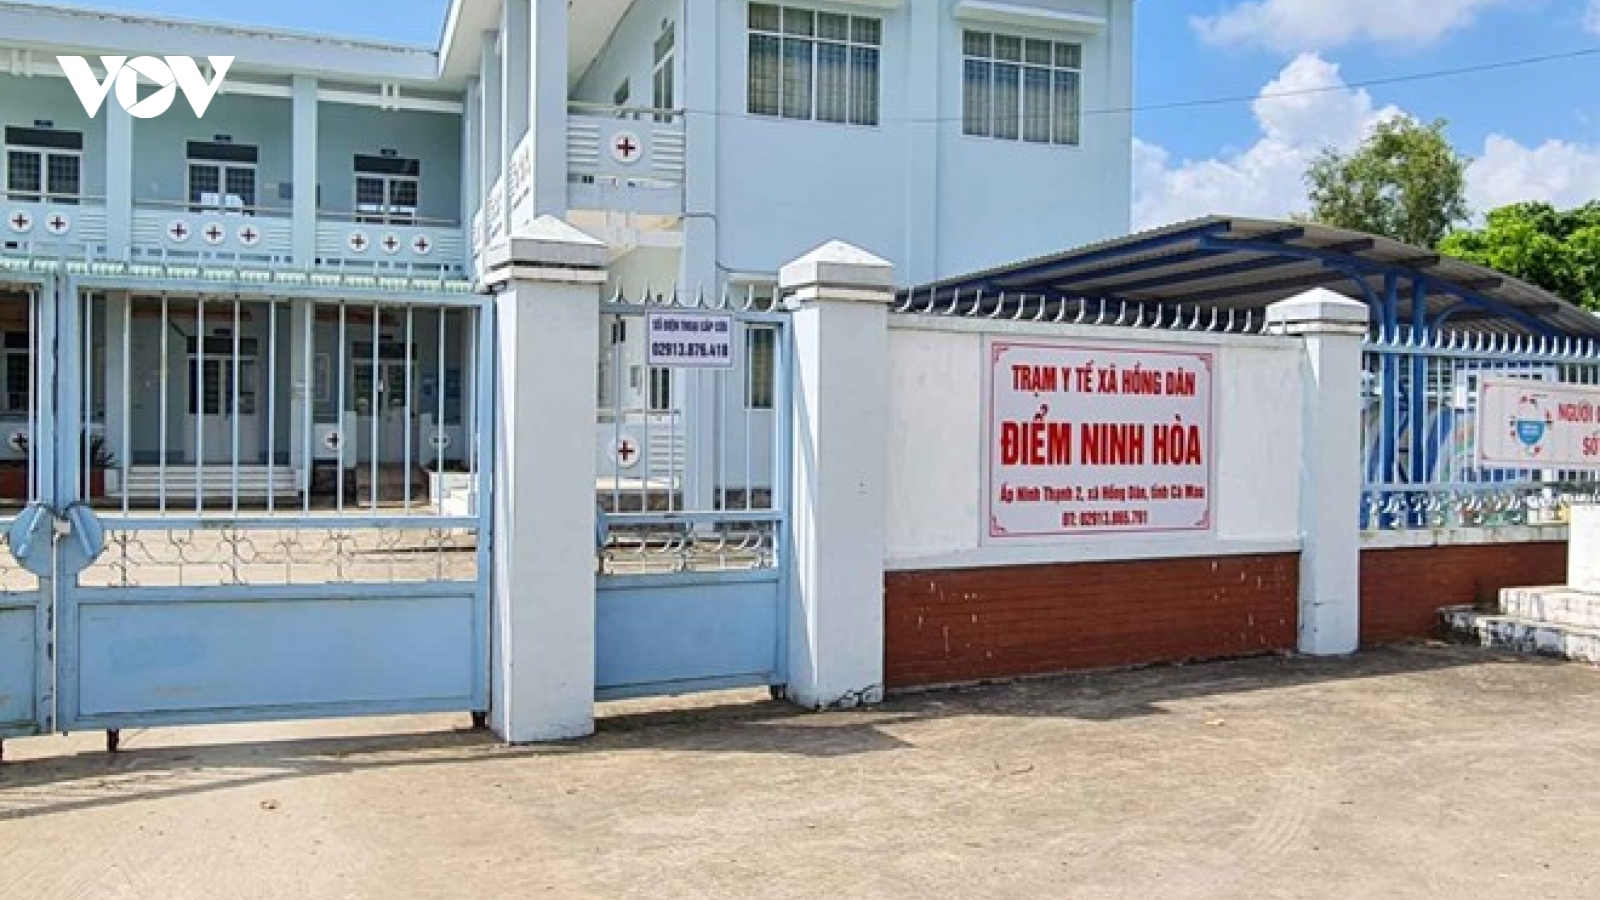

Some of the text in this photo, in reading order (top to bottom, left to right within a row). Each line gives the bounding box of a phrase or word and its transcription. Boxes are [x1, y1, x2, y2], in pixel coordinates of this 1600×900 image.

[1011, 360, 1196, 397] TRẠM Y TẾ XÃ HỒNG DÂN
[1000, 404, 1202, 465] ĐIỂM NINH HÒA
[1017, 485, 1040, 501] Ninh
